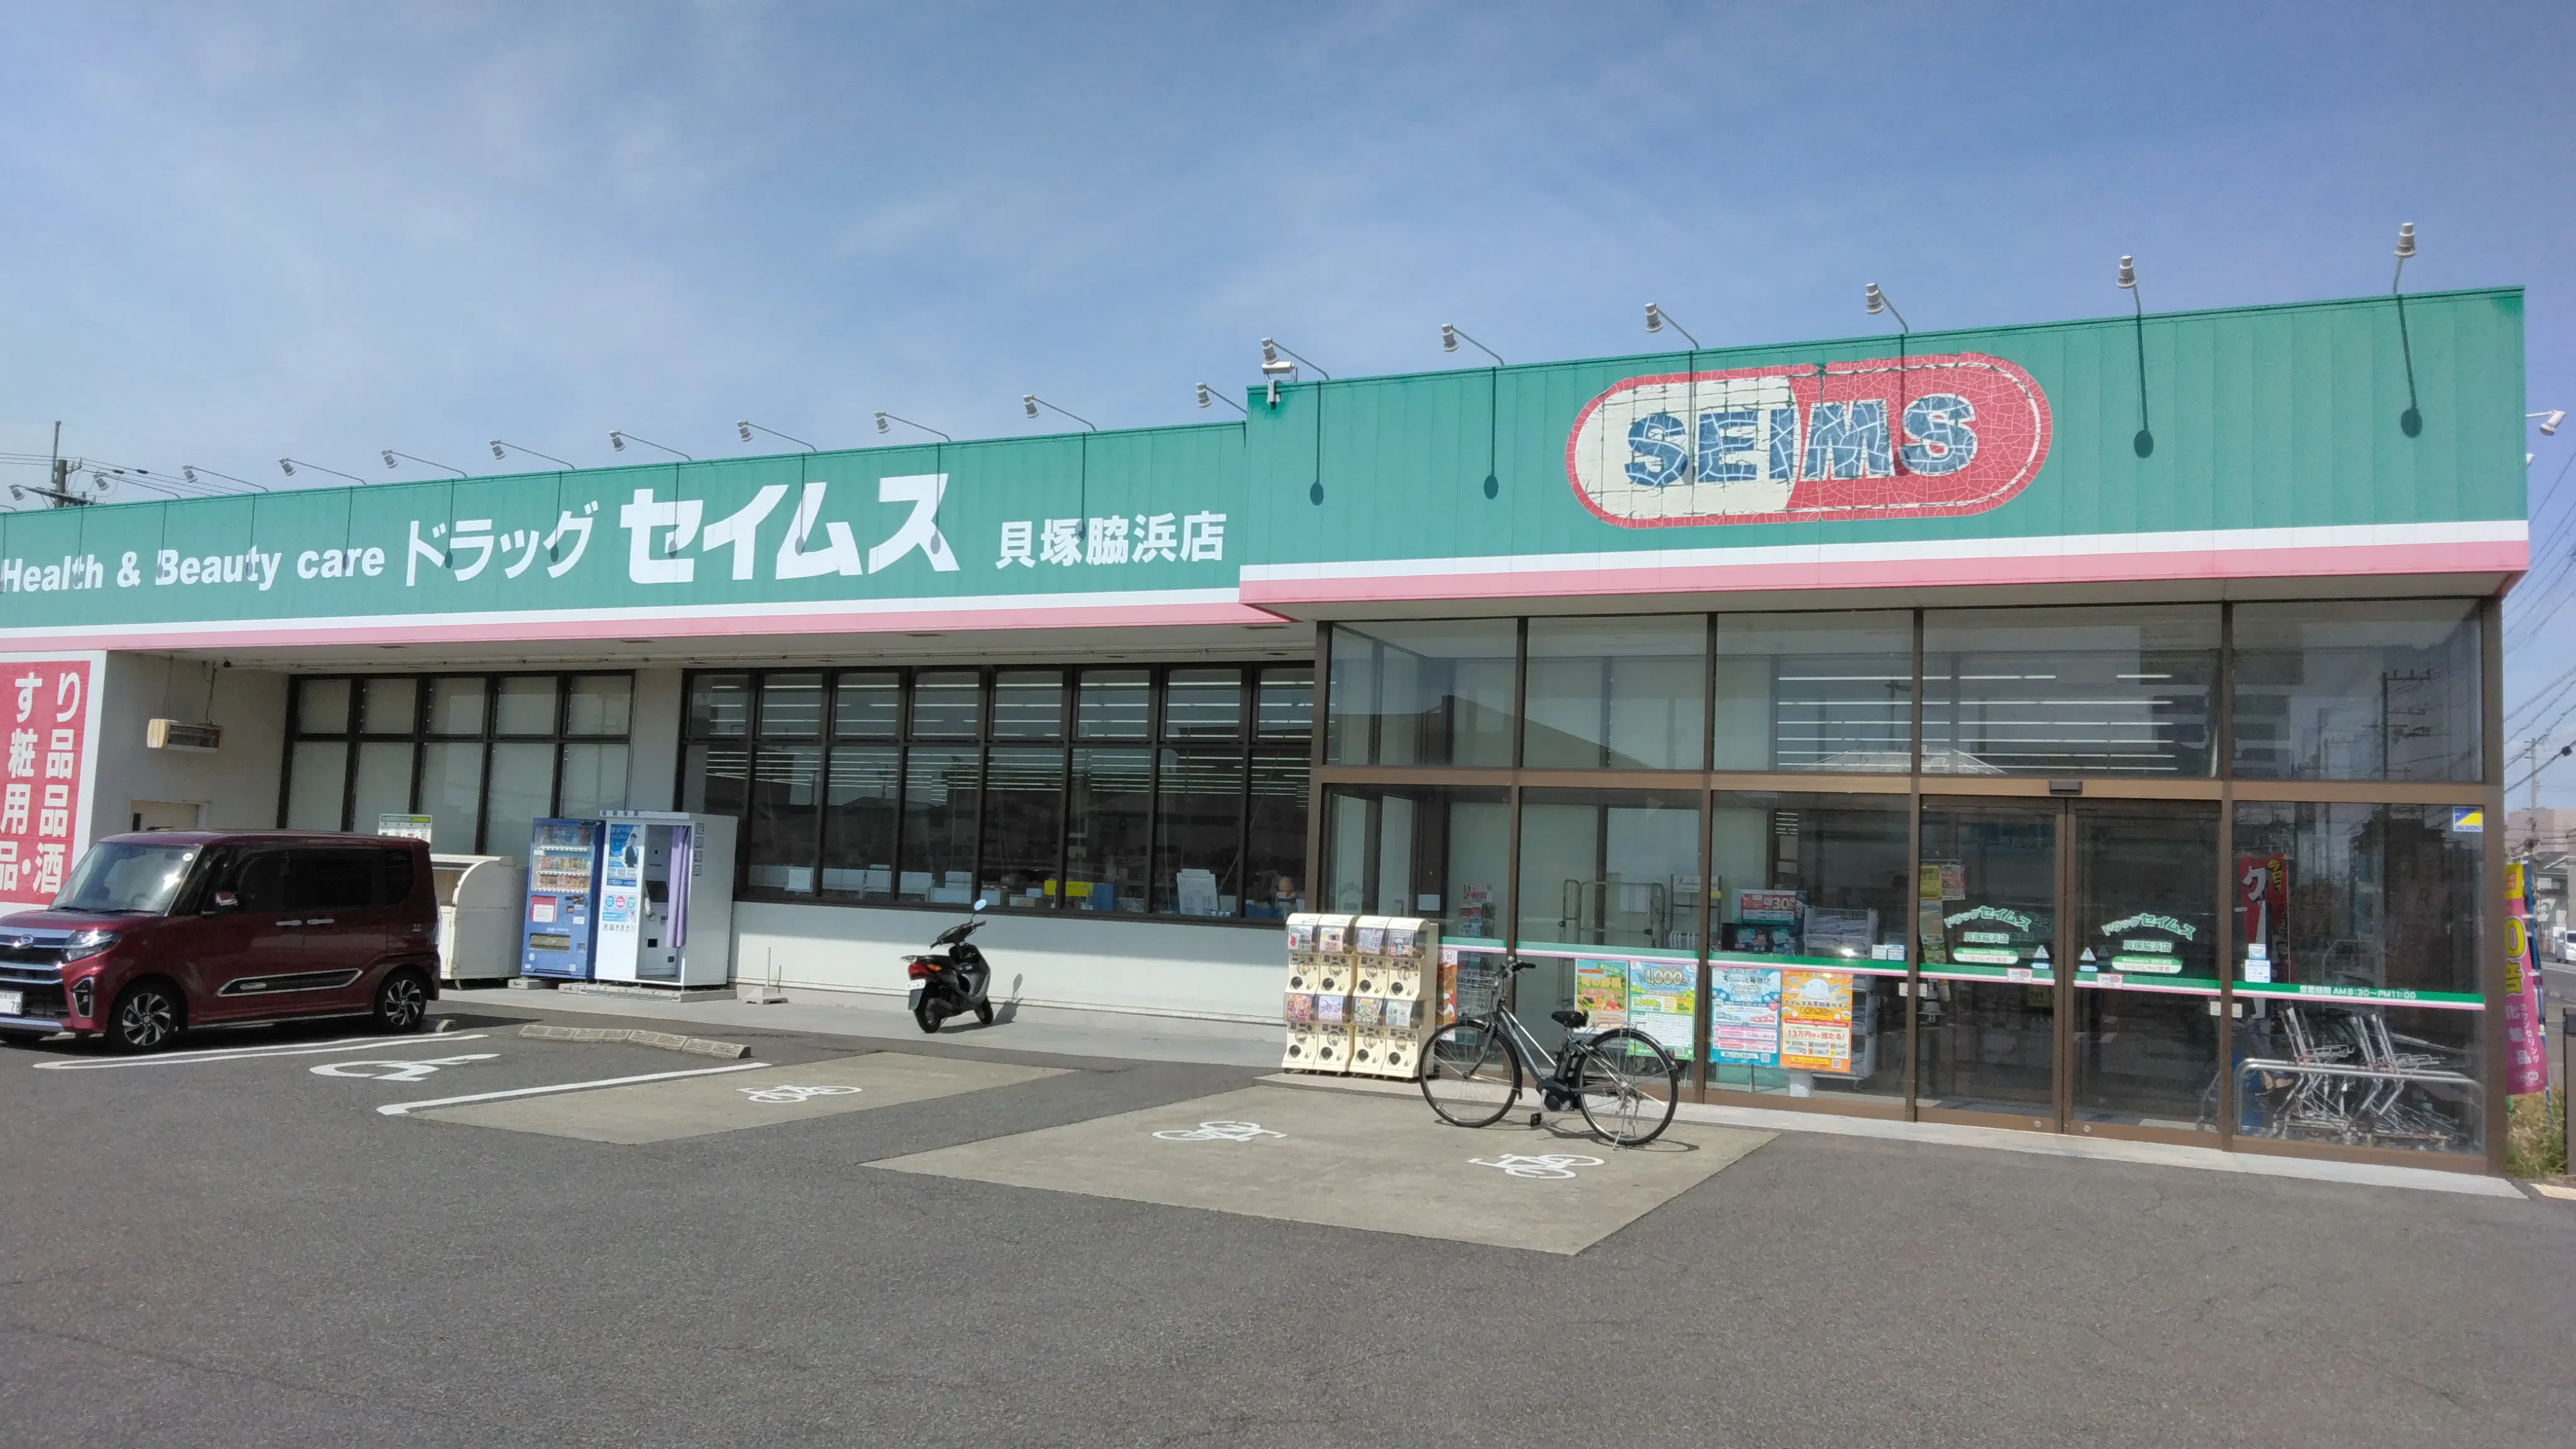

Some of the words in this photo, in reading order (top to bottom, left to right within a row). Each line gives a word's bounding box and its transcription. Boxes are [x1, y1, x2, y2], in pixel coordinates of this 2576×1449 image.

[1623, 394, 1979, 486] SEIMS
[406, 500, 599, 587] ドラッグ
[619, 473, 960, 584] セイムス
[994, 510, 1226, 570] 貝塚脇浜店
[1, 553, 103, 593] Health
[117, 552, 142, 588] &
[155, 545, 282, 591] Beauty
[297, 547, 385, 579] care
[1943, 908, 1981, 929] ドラッグ
[1980, 906, 2032, 933] セイムス
[2101, 916, 2141, 936] ドラッグ
[2140, 913, 2196, 941] セイムス
[2299, 985, 2331, 994] 営業時間
